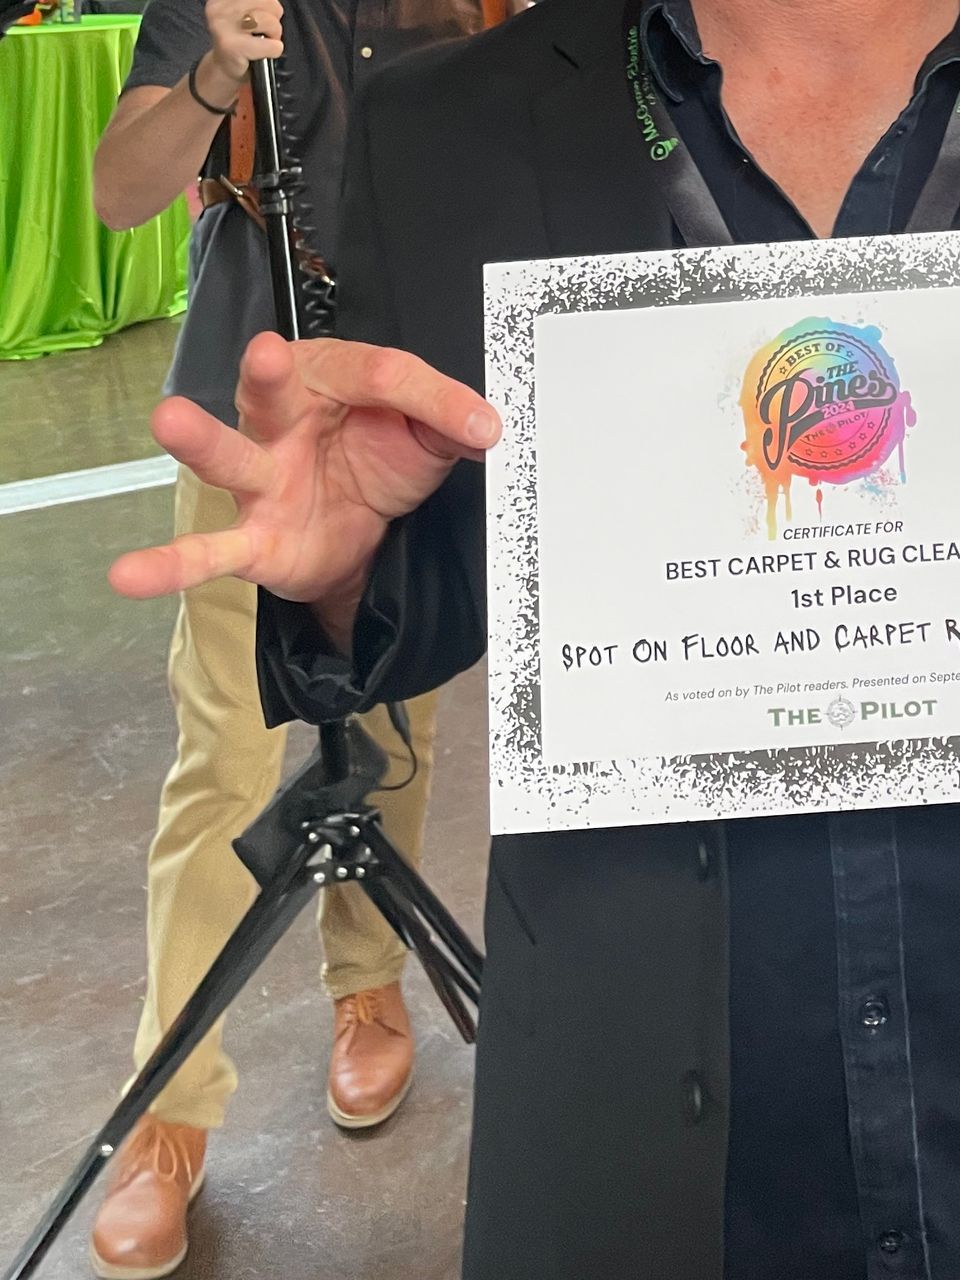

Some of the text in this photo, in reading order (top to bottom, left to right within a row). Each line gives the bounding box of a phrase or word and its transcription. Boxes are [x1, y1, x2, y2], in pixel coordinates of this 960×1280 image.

[786, 342, 846, 369] BEST OF
[826, 360, 859, 380] THE
[760, 367, 897, 470] Pines
[822, 400, 855, 420] 2024
[804, 412, 866, 442] THE PILOT
[783, 521, 904, 540] CERTIFICATE FOR
[666, 559, 721, 580] BEST
[728, 552, 817, 576] CARPET
[824, 551, 841, 569] &
[848, 546, 896, 567] RUG
[791, 585, 898, 609] 1st Place
[562, 644, 618, 671] SPOT
[633, 639, 667, 663] ON
[682, 634, 760, 661] FLOOR
[774, 628, 820, 654] AND
[835, 622, 931, 651] CARPET
[665, 690, 679, 702] As
[682, 687, 715, 701] voted
[718, 687, 732, 698] on
[735, 686, 750, 699] by
[753, 684, 773, 696] The
[776, 682, 801, 694] Pilot
[804, 678, 849, 691] readers.
[852, 673, 909, 689] Presented
[912, 673, 927, 684] on
[767, 700, 938, 727] THE PILOT
